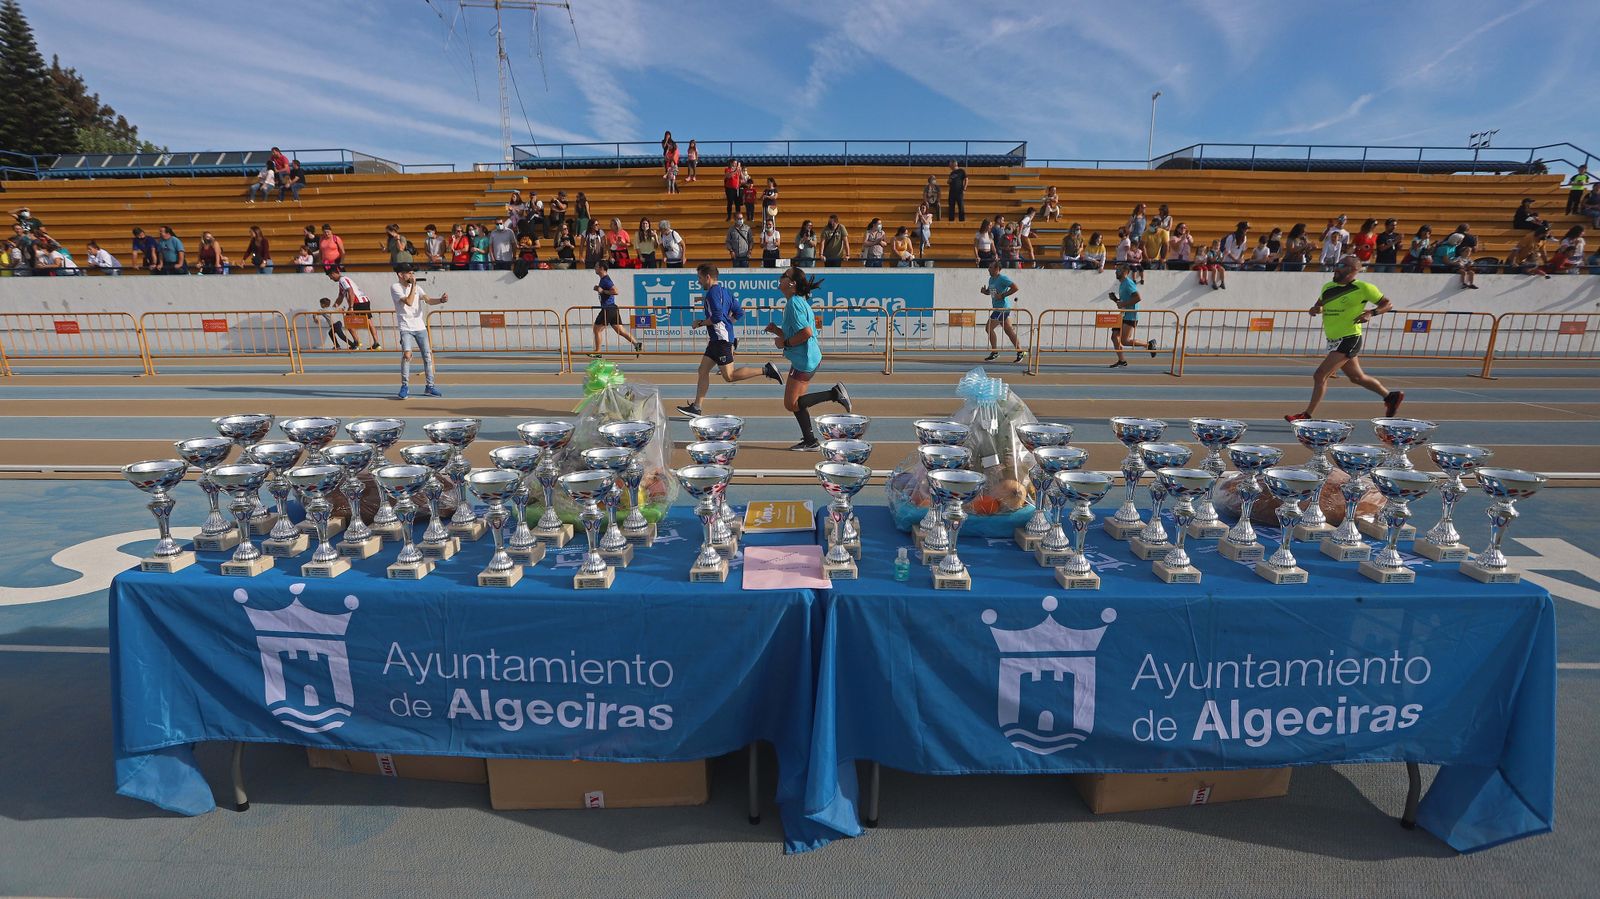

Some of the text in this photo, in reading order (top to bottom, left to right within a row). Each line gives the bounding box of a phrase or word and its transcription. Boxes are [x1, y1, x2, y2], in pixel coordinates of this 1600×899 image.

[688, 280, 737, 290] ESDIO
[808, 291, 907, 313] alavera
[382, 641, 674, 688] Ayuntamiento
[1131, 649, 1432, 700] Ayuntamiento
[389, 688, 674, 732] de Algeciras
[1132, 696, 1424, 748] de Algeciras
